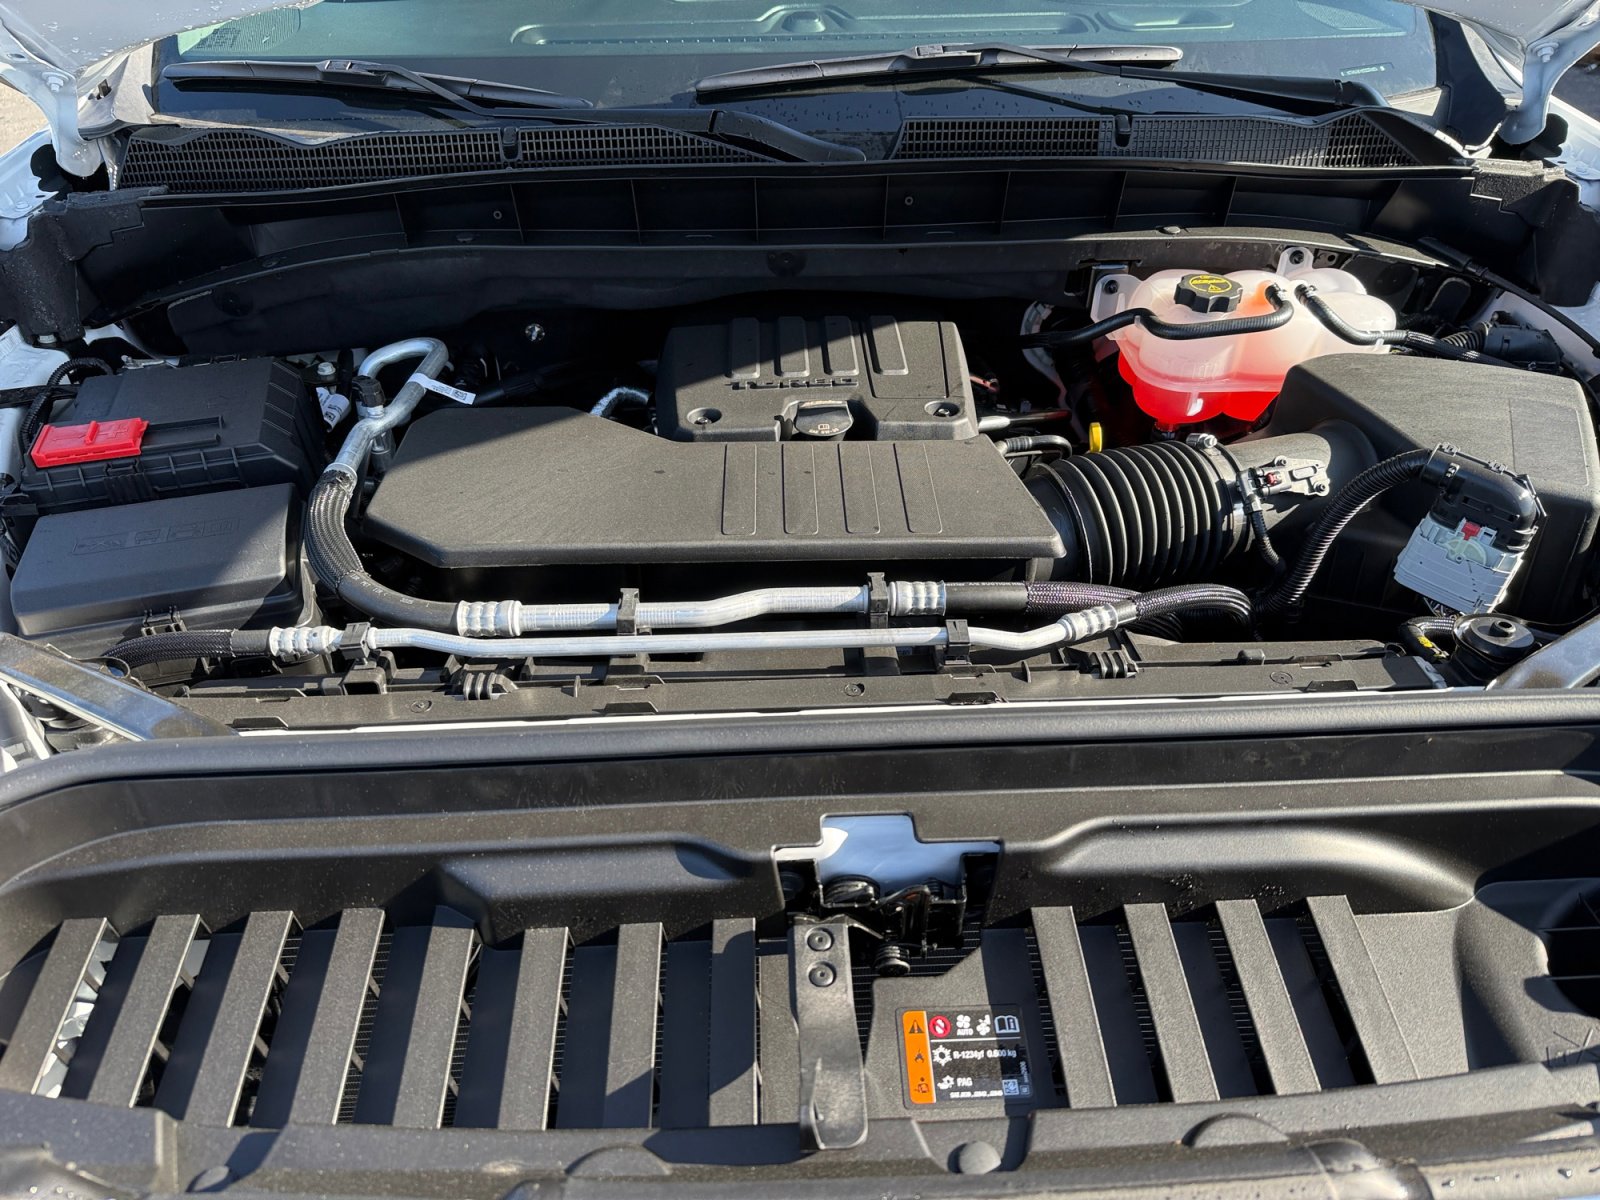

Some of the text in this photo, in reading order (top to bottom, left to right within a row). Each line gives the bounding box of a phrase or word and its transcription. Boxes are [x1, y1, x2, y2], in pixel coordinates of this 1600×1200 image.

[957, 1028, 973, 1036] AUTO
[953, 1050, 984, 1060] R-1234yf
[1007, 1049, 1017, 1058] kg
[957, 1077, 973, 1087] PAG
